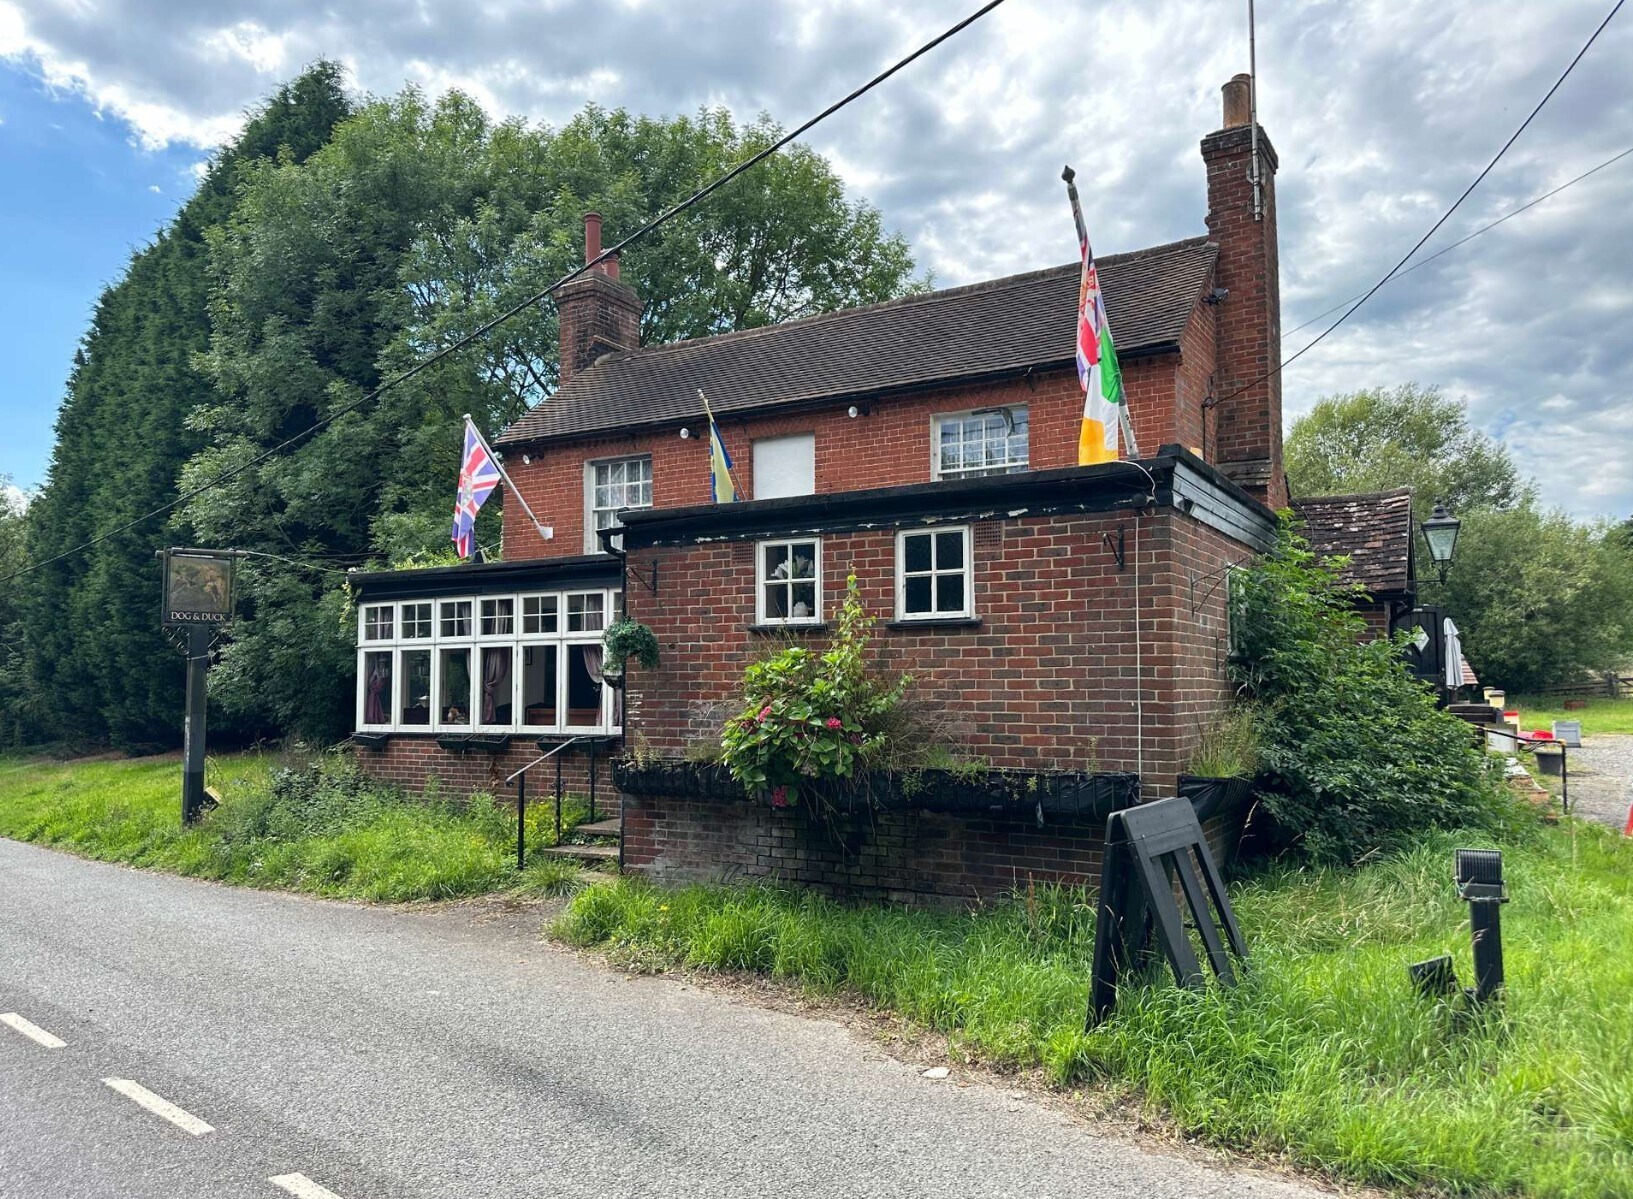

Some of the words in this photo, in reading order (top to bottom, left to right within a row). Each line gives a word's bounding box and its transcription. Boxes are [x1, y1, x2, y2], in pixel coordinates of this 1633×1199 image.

[171, 612, 192, 620] DOG
[193, 612, 200, 620] &
[201, 612, 226, 621] DUCK
